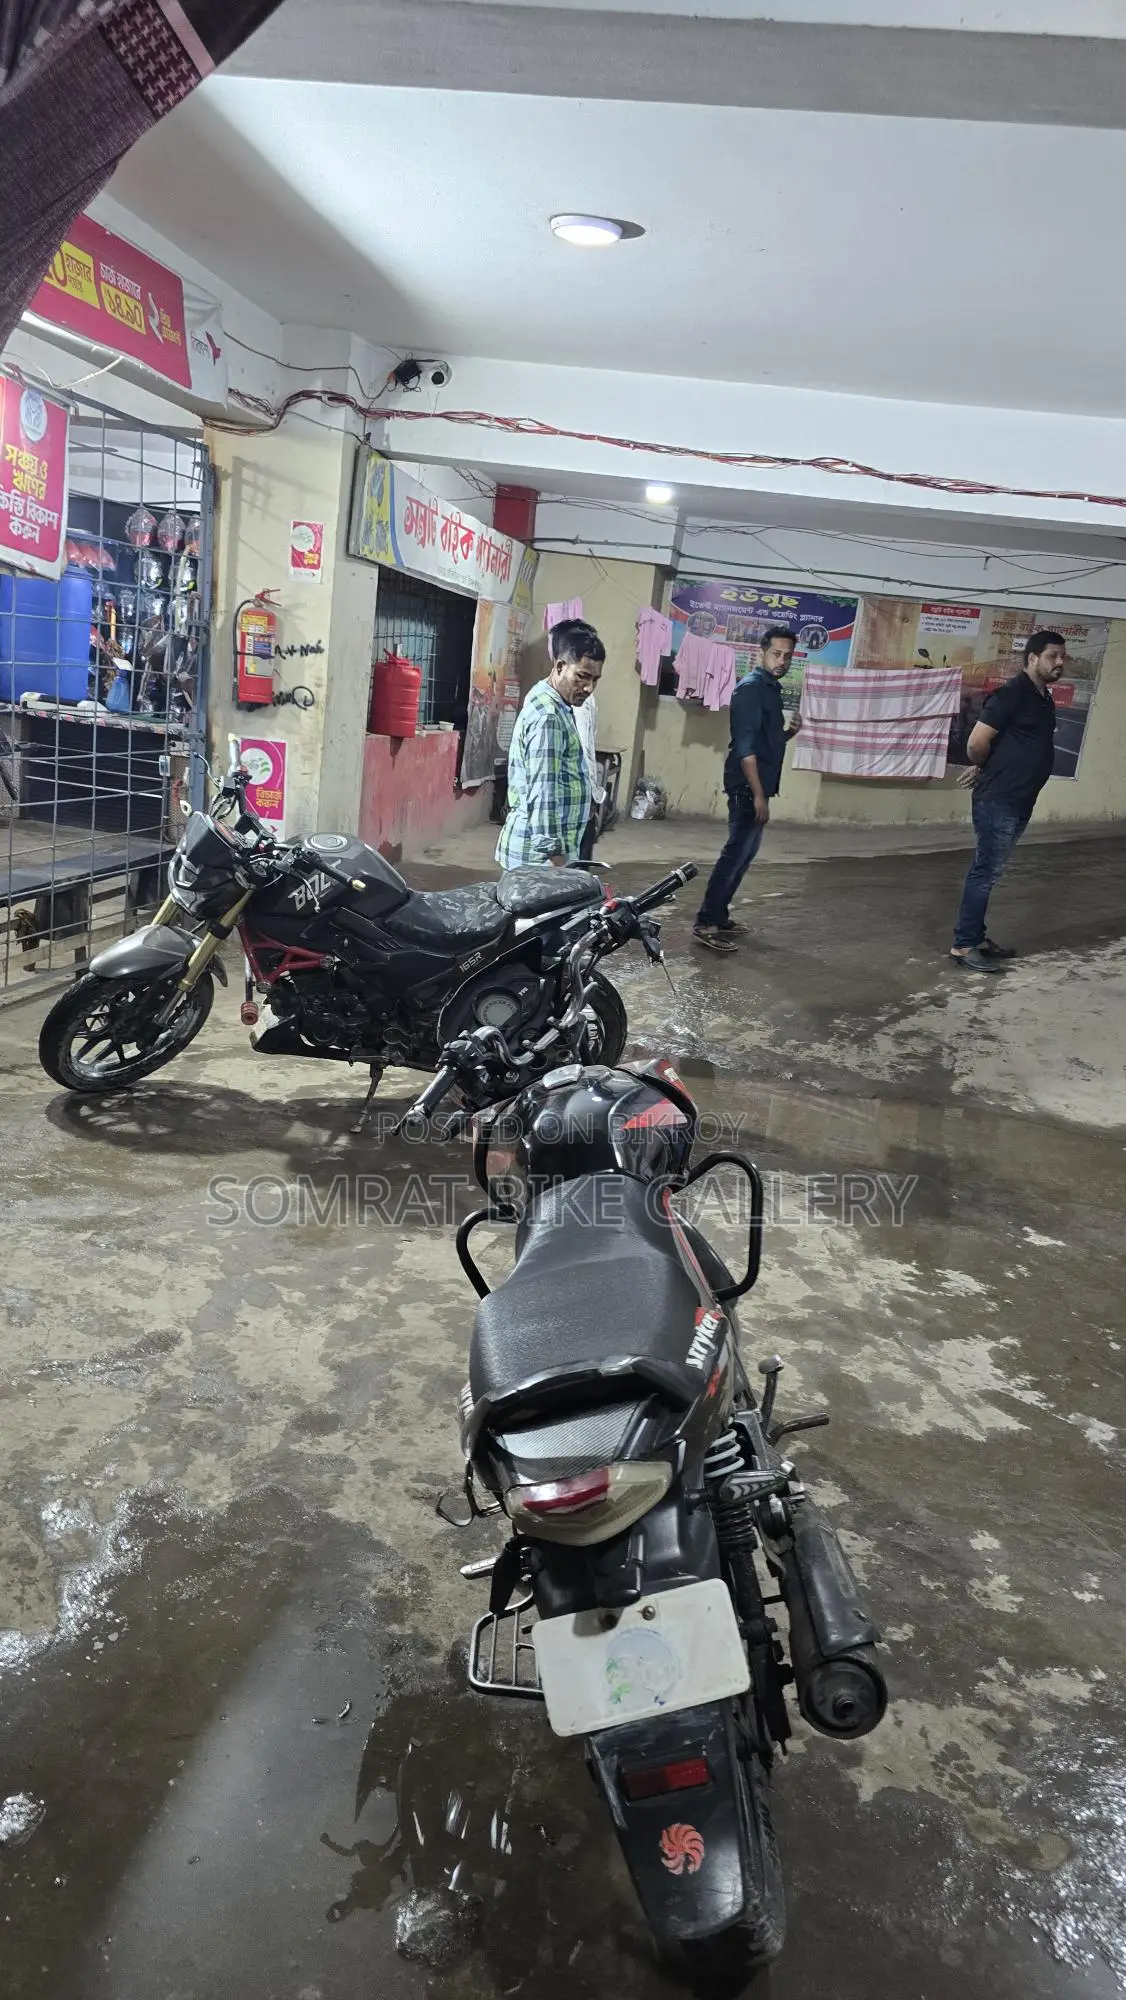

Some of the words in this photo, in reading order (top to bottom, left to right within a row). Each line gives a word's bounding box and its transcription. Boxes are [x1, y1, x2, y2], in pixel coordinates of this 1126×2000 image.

[39, 460, 48, 480] ও
[26, 496, 59, 529] বিকাশ
[440, 511, 475, 565] বাইক
